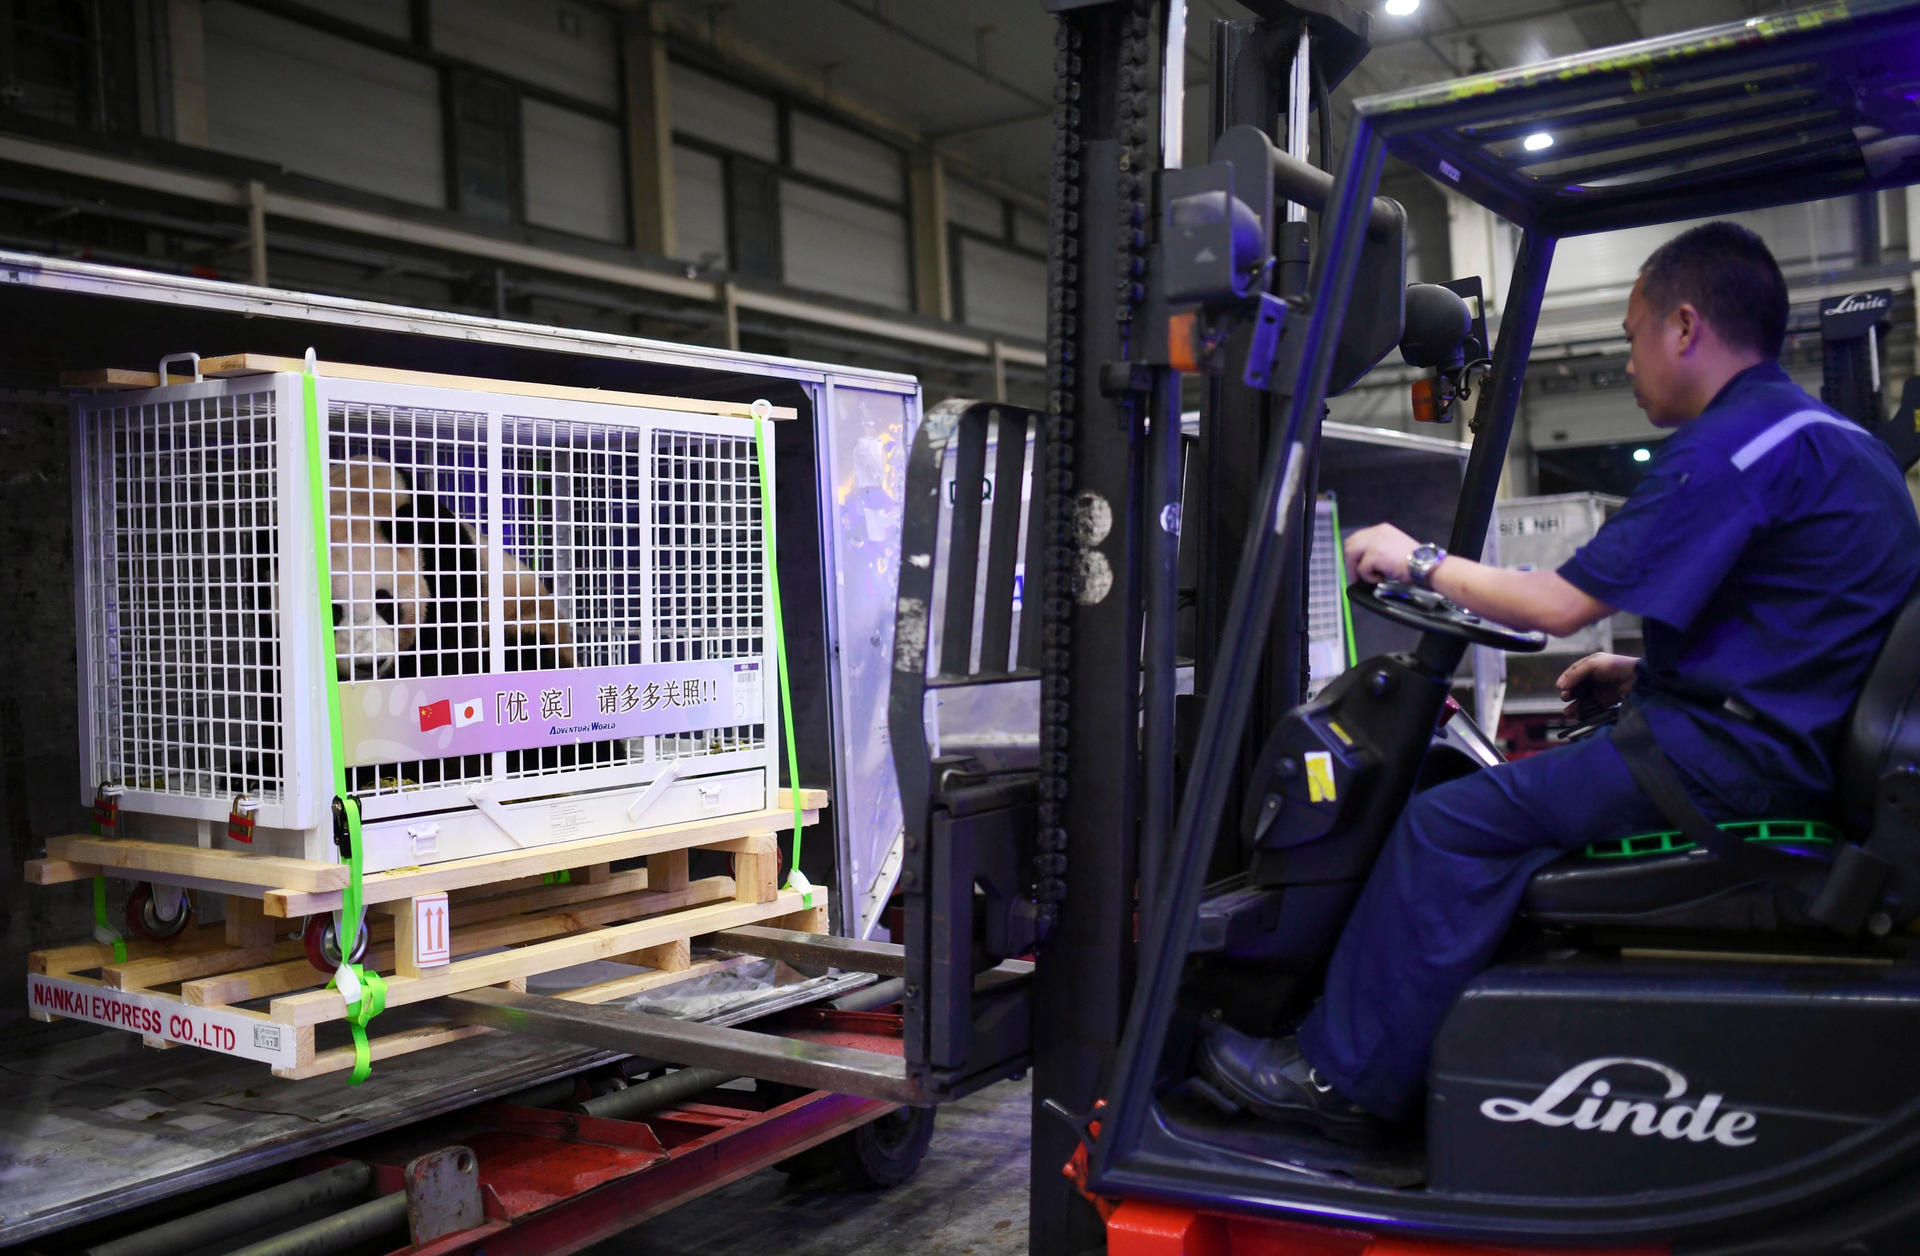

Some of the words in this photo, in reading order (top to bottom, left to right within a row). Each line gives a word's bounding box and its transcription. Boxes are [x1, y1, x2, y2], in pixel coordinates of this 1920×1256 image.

[33, 983, 88, 1016] NANKAI
[92, 997, 162, 1034] EXPRESS
[1480, 1057, 1756, 1146] Linde
